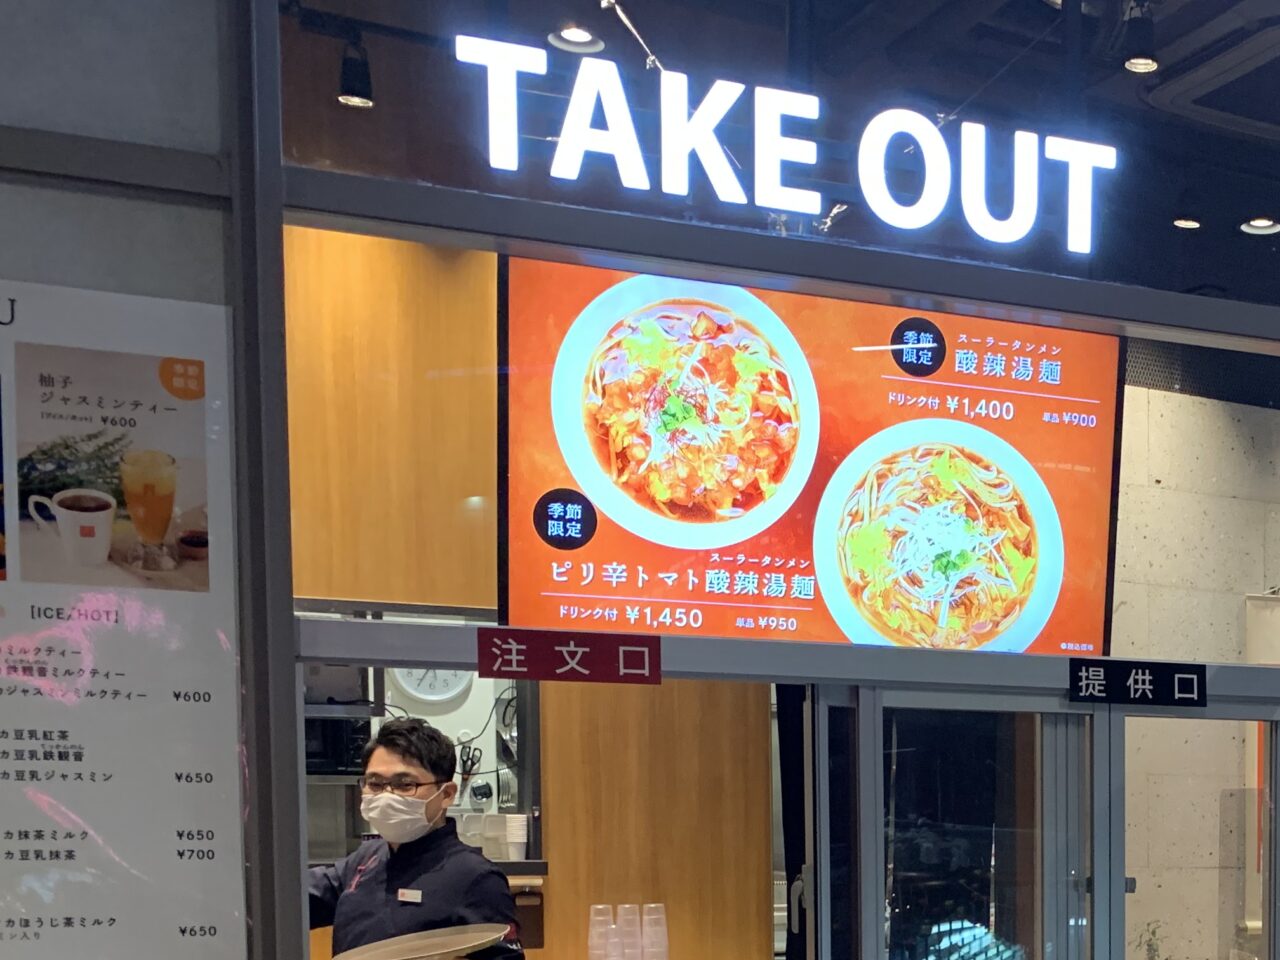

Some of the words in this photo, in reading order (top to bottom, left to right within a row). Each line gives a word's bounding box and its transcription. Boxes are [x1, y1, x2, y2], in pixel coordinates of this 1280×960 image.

[455, 34, 822, 216] TAKE
[857, 108, 1117, 255] OUT
[957, 334, 1062, 355] スーラータンメン
[38, 373, 73, 389] 柚子
[40, 391, 177, 415] ジャスミンティー
[888, 392, 940, 410] ドリンク付
[946, 395, 1014, 421] ¥1,400
[1062, 411, 1097, 428] ¥900
[101, 416, 137, 428] ¥600
[547, 502, 582, 520] 季節
[547, 521, 582, 538] 限定
[709, 552, 811, 569] スーラータンメン
[558, 604, 618, 622] ドリンク付
[625, 605, 703, 629] ¥1,450
[758, 616, 797, 631] ¥950
[0, 645, 82, 658] ミルクティー
[491, 637, 650, 677] 注文口
[0, 665, 126, 679] 鉄観音ミルクティー
[1078, 665, 1199, 701] 提供口
[173, 691, 212, 704] ¥600
[175, 773, 214, 784] ¥650
[176, 830, 215, 842] ¥650
[177, 849, 215, 861] ¥700
[0, 932, 41, 941] ン入り
[179, 926, 218, 938] ¥650
